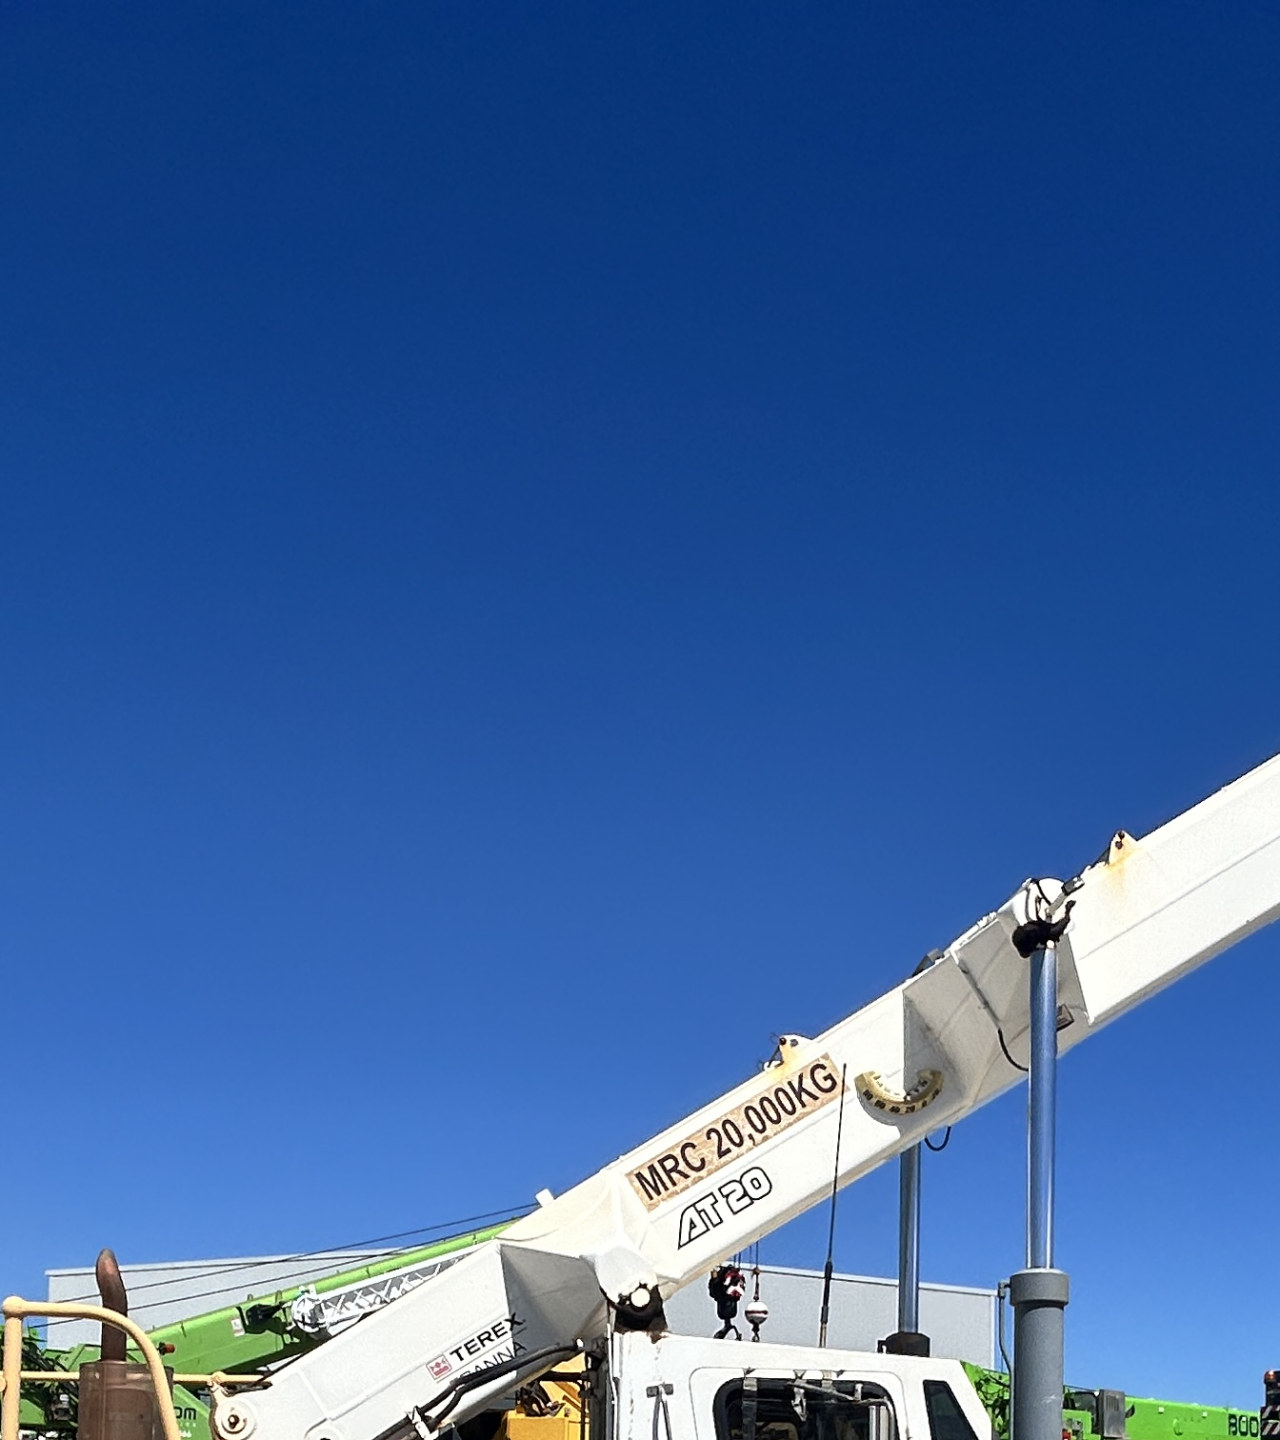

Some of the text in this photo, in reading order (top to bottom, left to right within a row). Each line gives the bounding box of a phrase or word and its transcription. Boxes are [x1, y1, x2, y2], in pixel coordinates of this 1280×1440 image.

[634, 1063, 838, 1201] MRC 20,000KG
[678, 1166, 773, 1250] AT 20
[449, 1311, 520, 1362] TEREX
[1227, 1413, 1260, 1438] BOO
